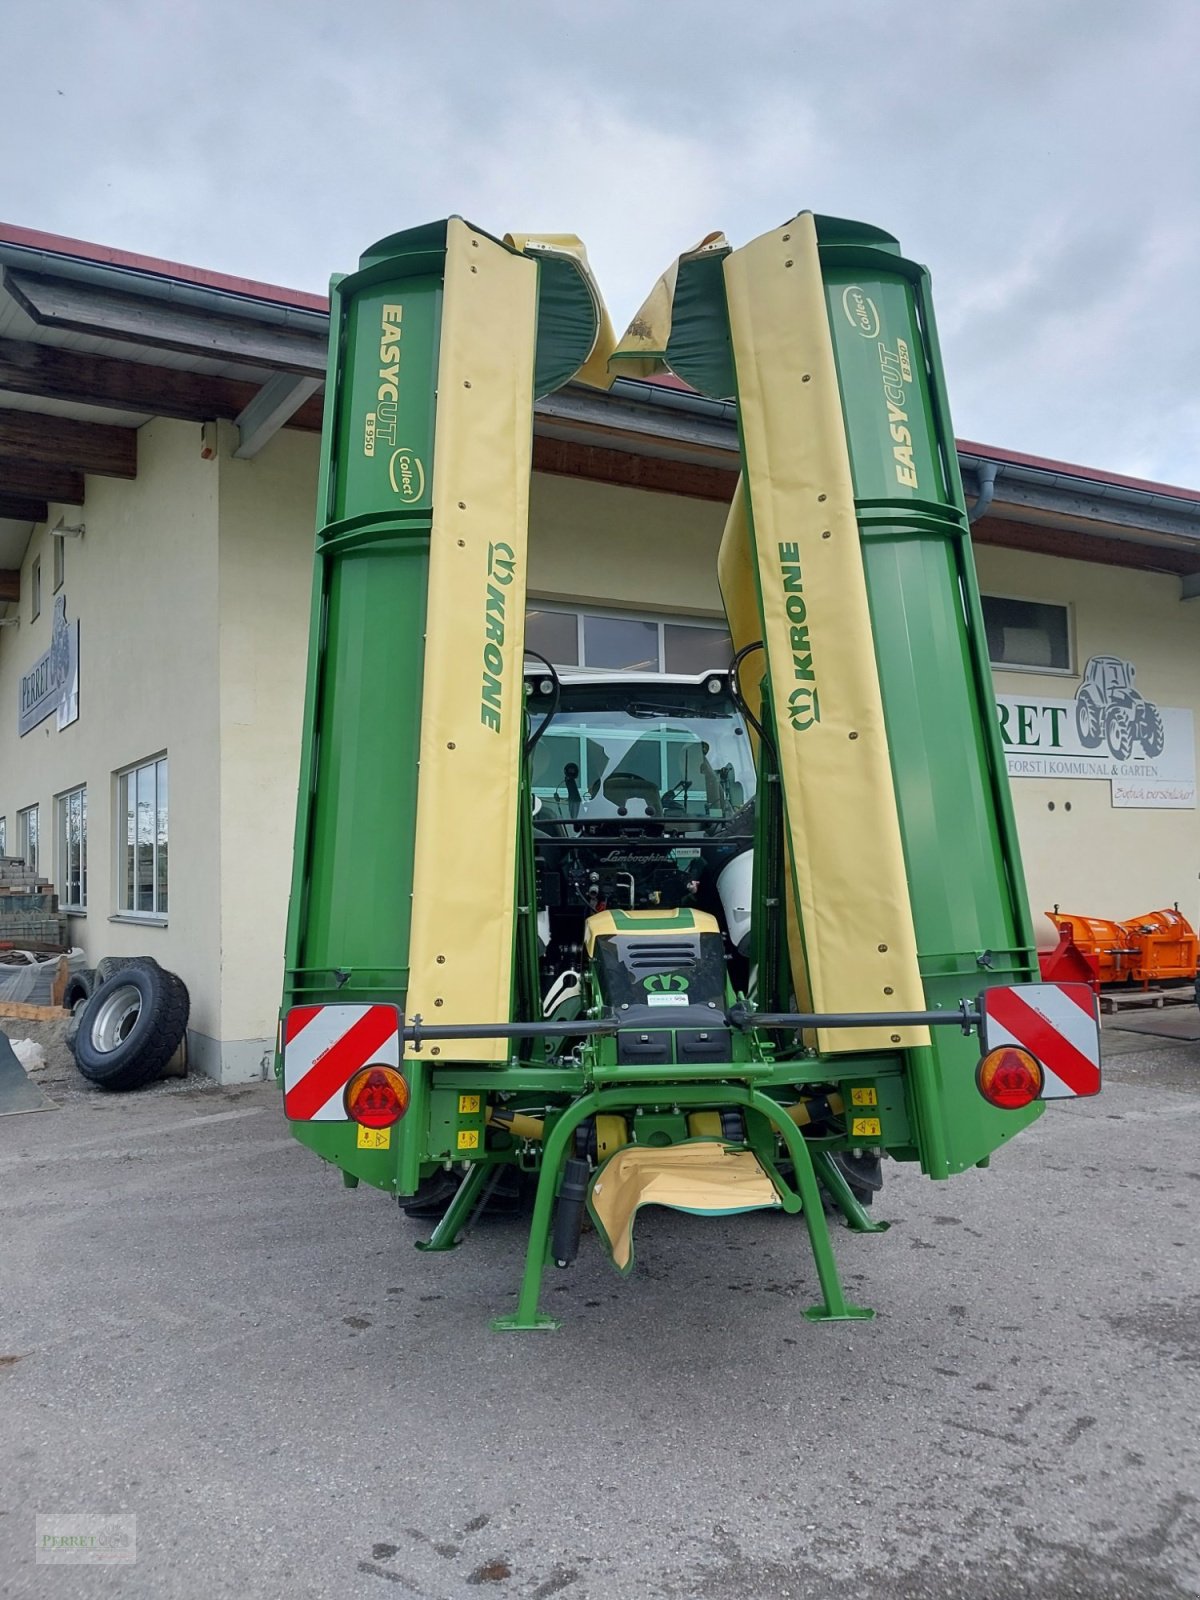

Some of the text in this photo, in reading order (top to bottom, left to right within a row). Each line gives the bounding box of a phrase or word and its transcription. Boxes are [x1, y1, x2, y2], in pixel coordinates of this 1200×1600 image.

[376, 304, 403, 446] EASYCUT
[899, 345, 909, 366] 950
[365, 430, 374, 451] 950
[878, 342, 918, 488] EASYCUT
[481, 583, 506, 734] KRONE
[778, 542, 816, 681] KRONE
[22, 657, 50, 712] PERRET
[1008, 759, 1042, 773] FORST
[1049, 761, 1110, 777] KOMMUNAL
[1120, 764, 1159, 778] GARTEN
